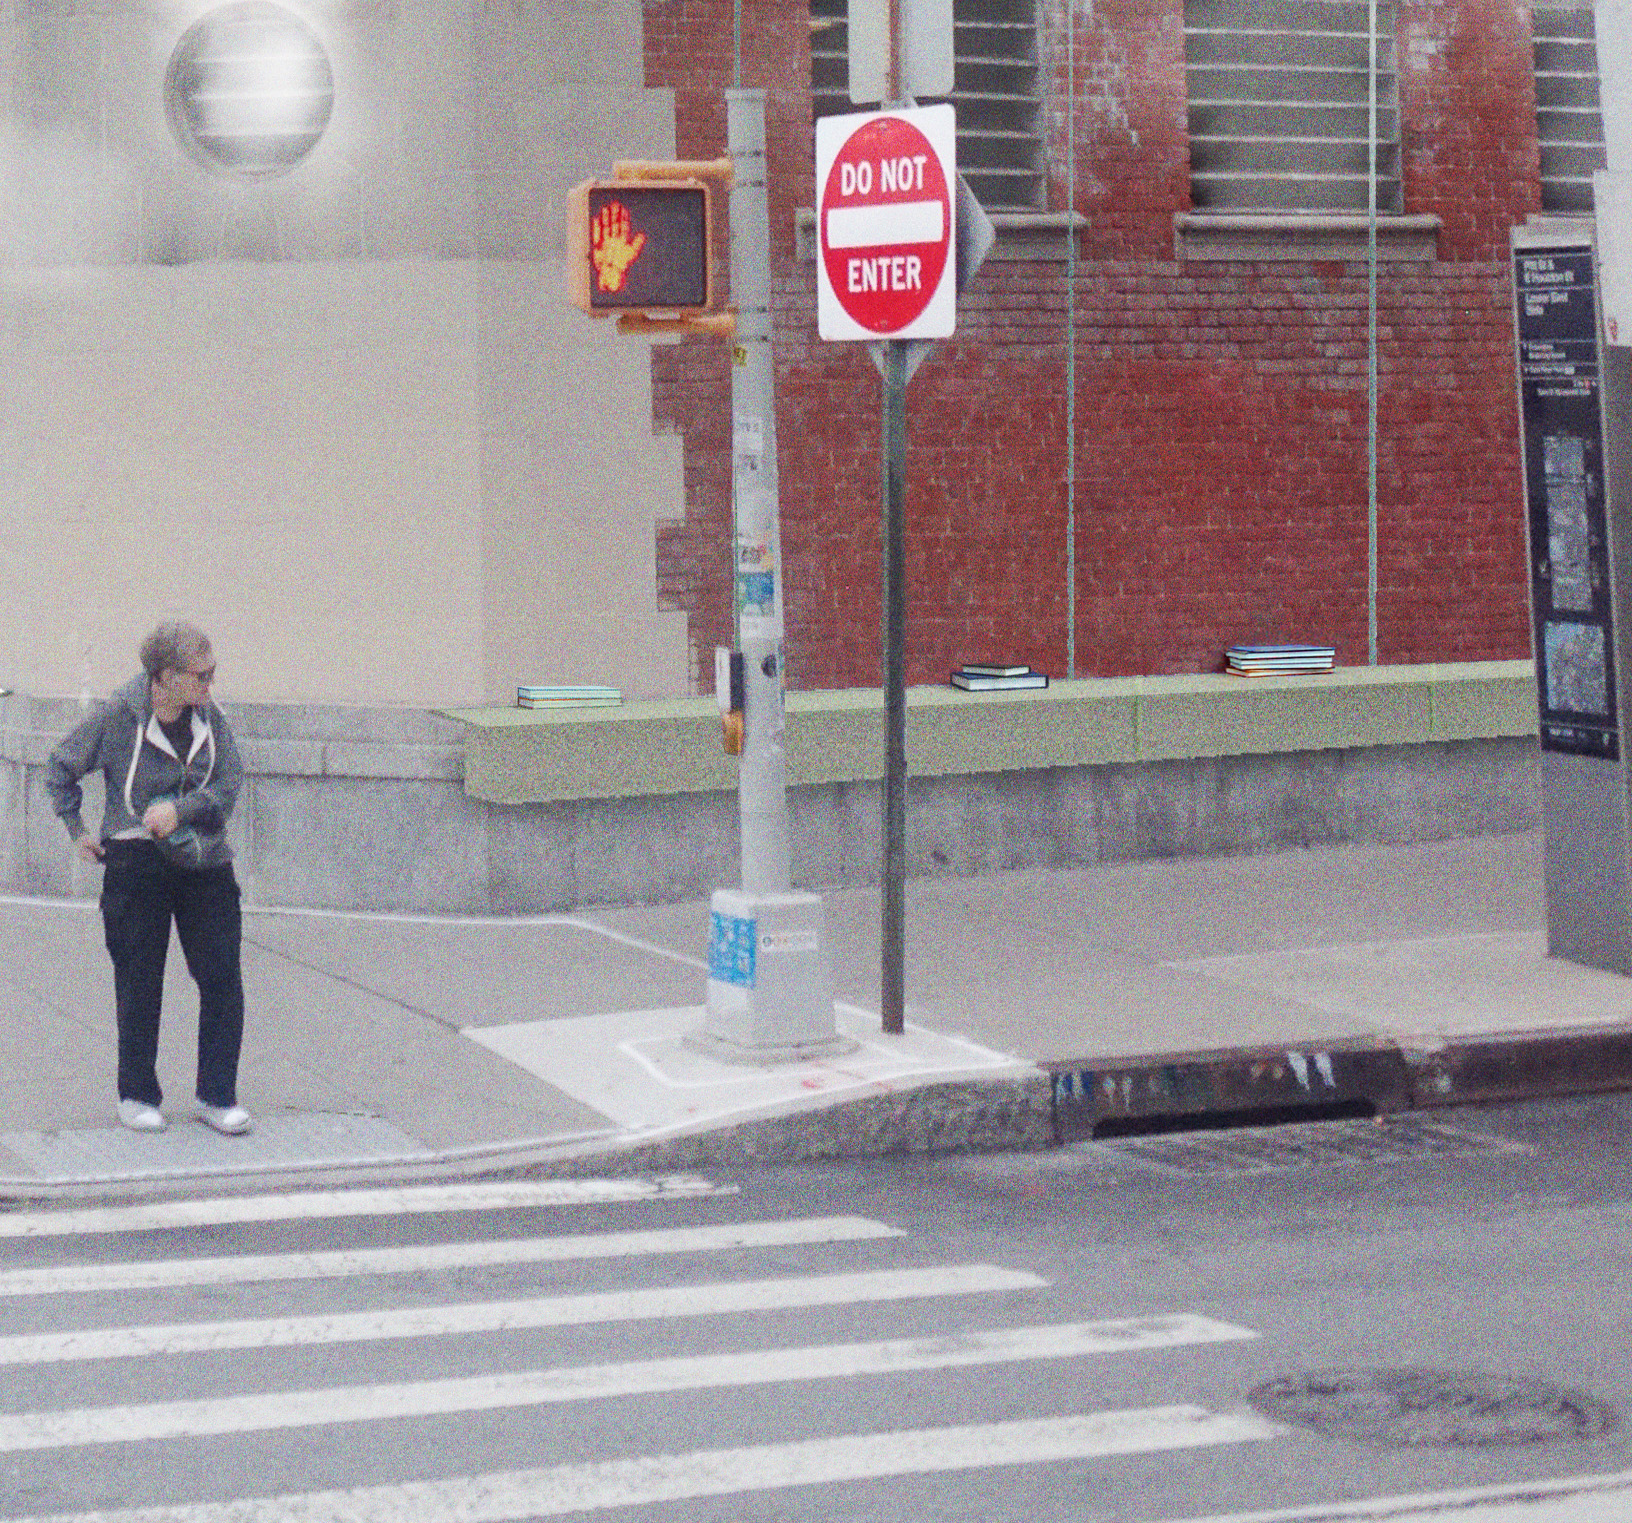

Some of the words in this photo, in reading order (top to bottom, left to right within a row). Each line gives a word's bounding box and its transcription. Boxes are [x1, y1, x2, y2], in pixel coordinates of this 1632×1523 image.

[840, 160, 873, 196] DO
[880, 155, 928, 193] NOT
[847, 254, 922, 294] ENTER
